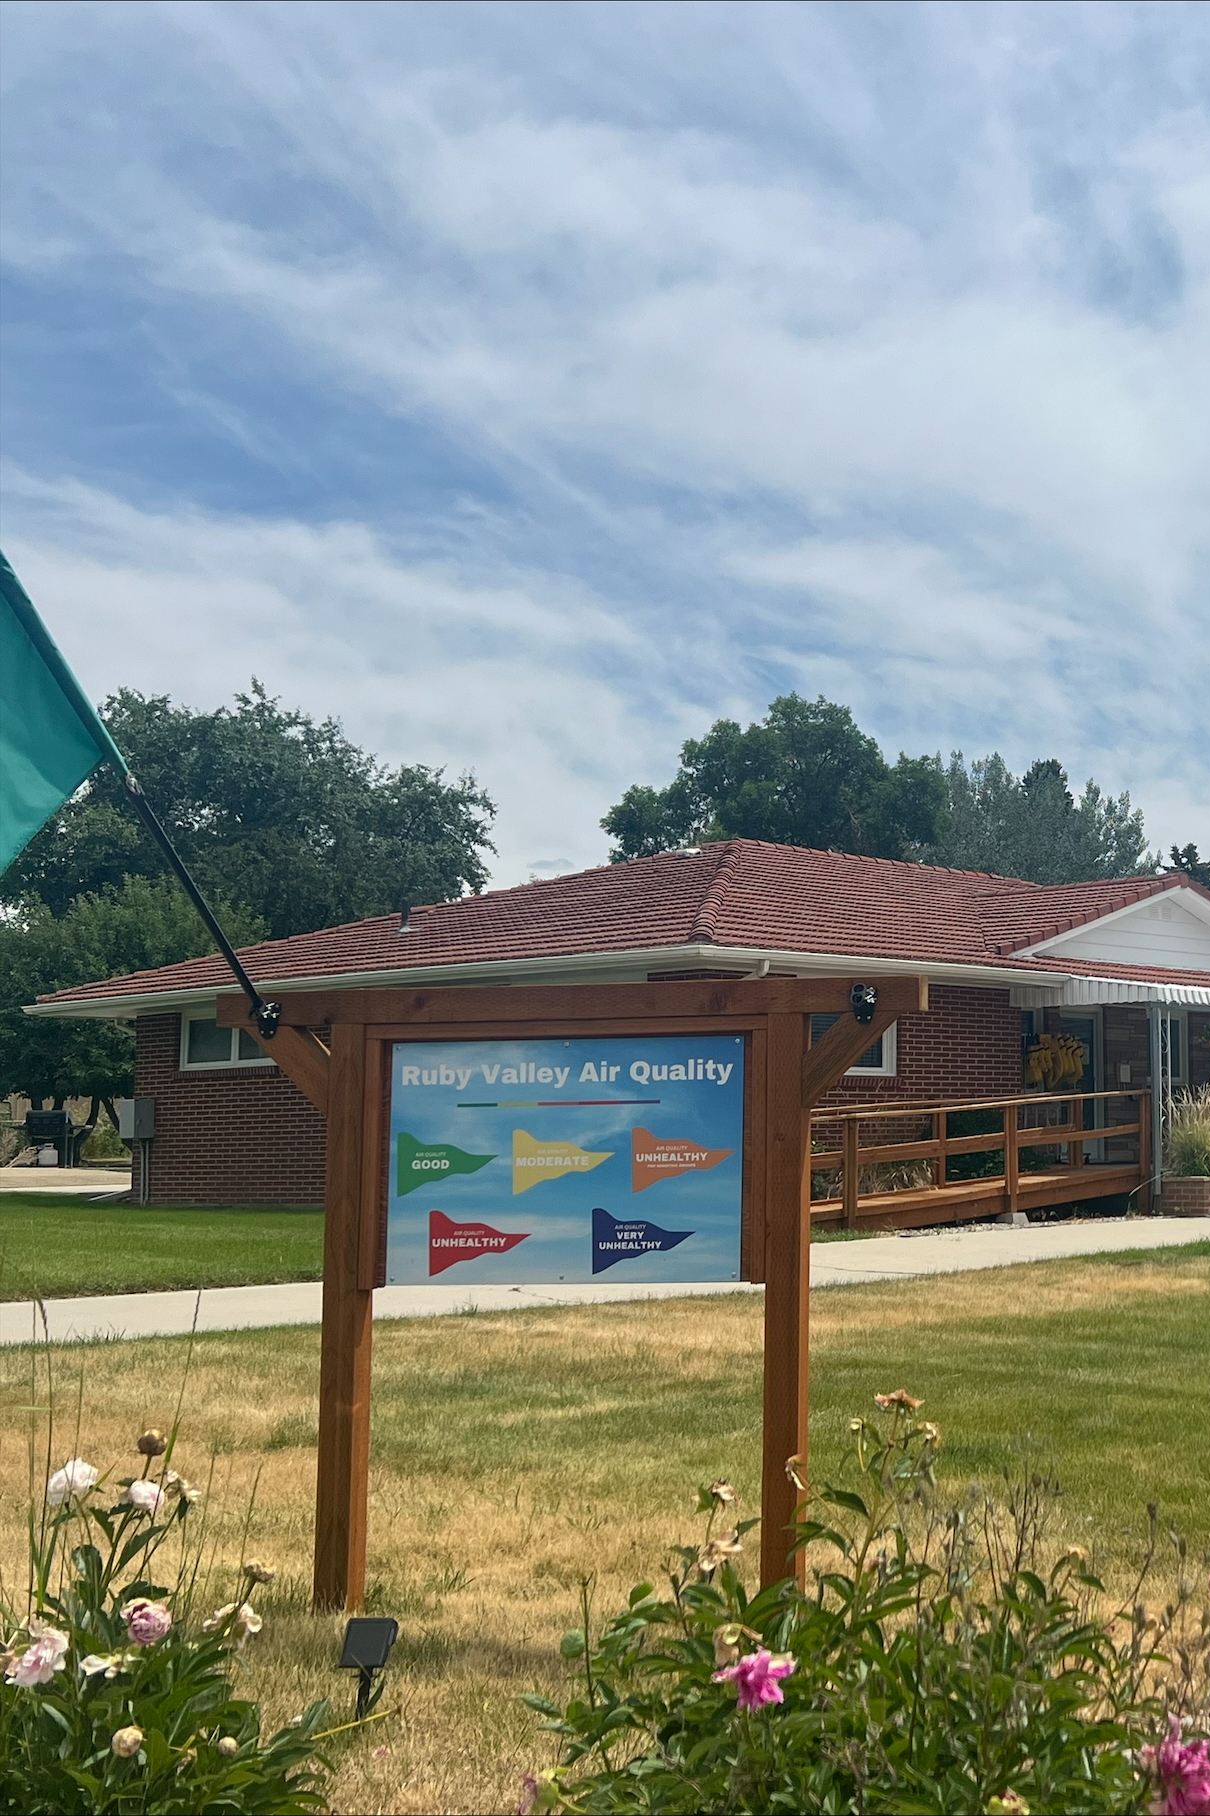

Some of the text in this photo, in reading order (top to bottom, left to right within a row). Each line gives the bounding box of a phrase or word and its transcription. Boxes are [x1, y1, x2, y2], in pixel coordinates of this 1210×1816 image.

[401, 1058, 734, 1091] Ruby Valley Air Quality
[515, 1156, 589, 1167] MODERATE
[636, 1152, 708, 1162] UNHEALTHY
[411, 1159, 450, 1170] GOOD
[616, 1231, 644, 1240] VERY
[432, 1237, 507, 1248] UNHEALTHY
[599, 1241, 662, 1250] UNHEALTHY
